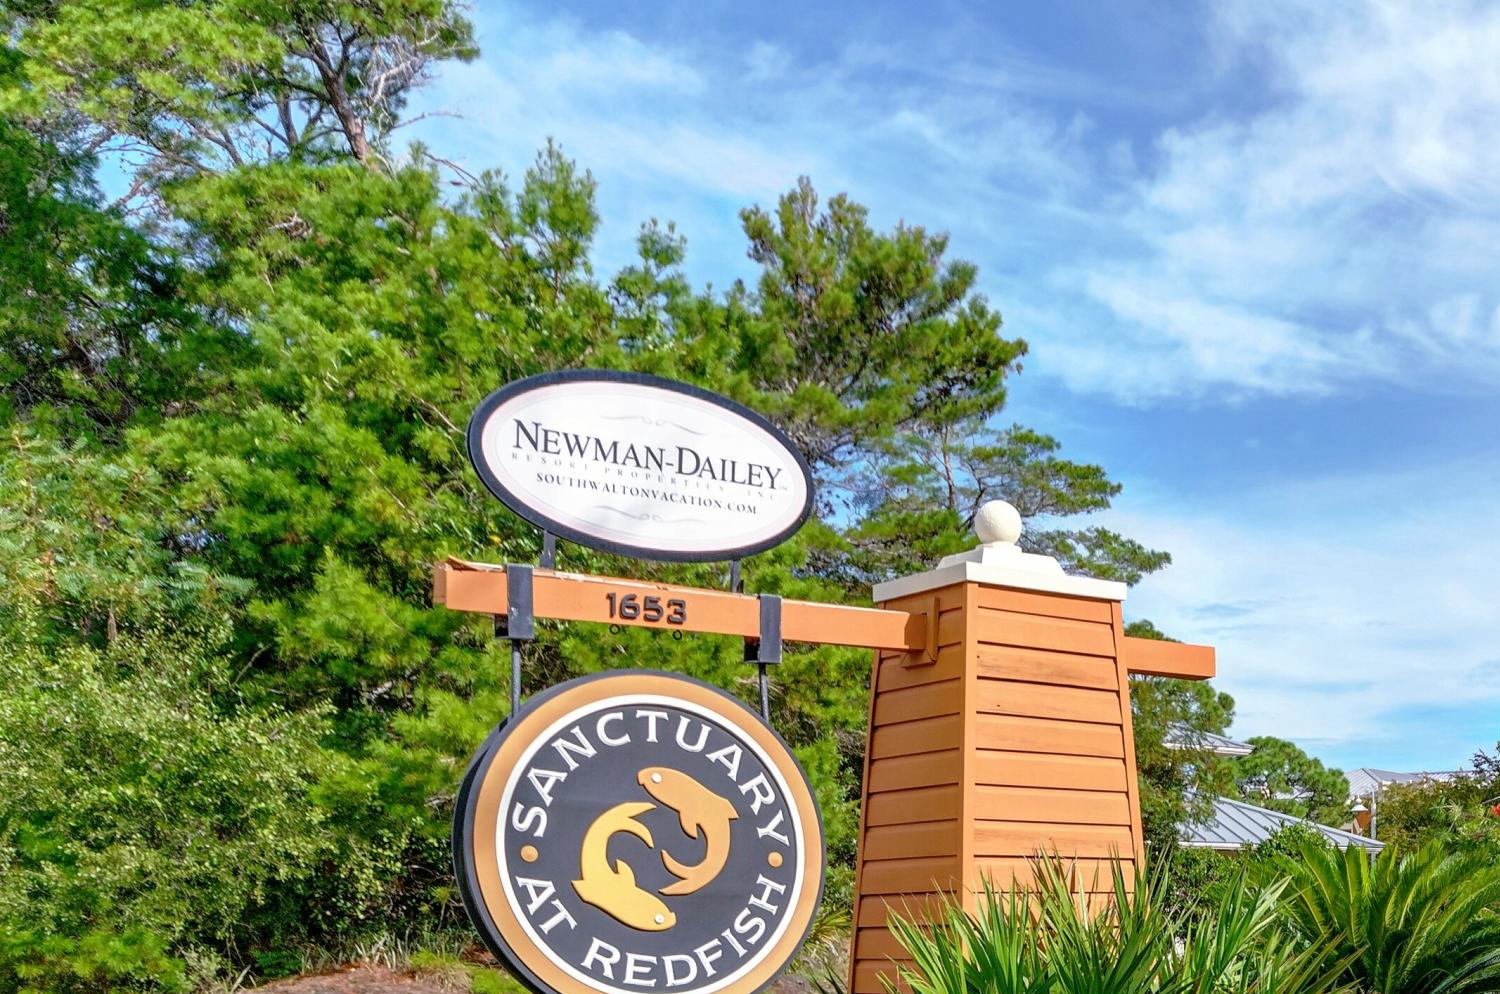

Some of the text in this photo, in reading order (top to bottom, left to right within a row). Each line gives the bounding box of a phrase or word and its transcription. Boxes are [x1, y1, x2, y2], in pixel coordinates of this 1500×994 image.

[512, 418, 782, 490] NEWMAN-DAILEY
[536, 472, 757, 515] SOUTHWALTONVACATION.COM
[606, 591, 687, 624] 1653
[511, 709, 790, 847] SANCTUARY
[515, 874, 787, 988] AT REDFISH
